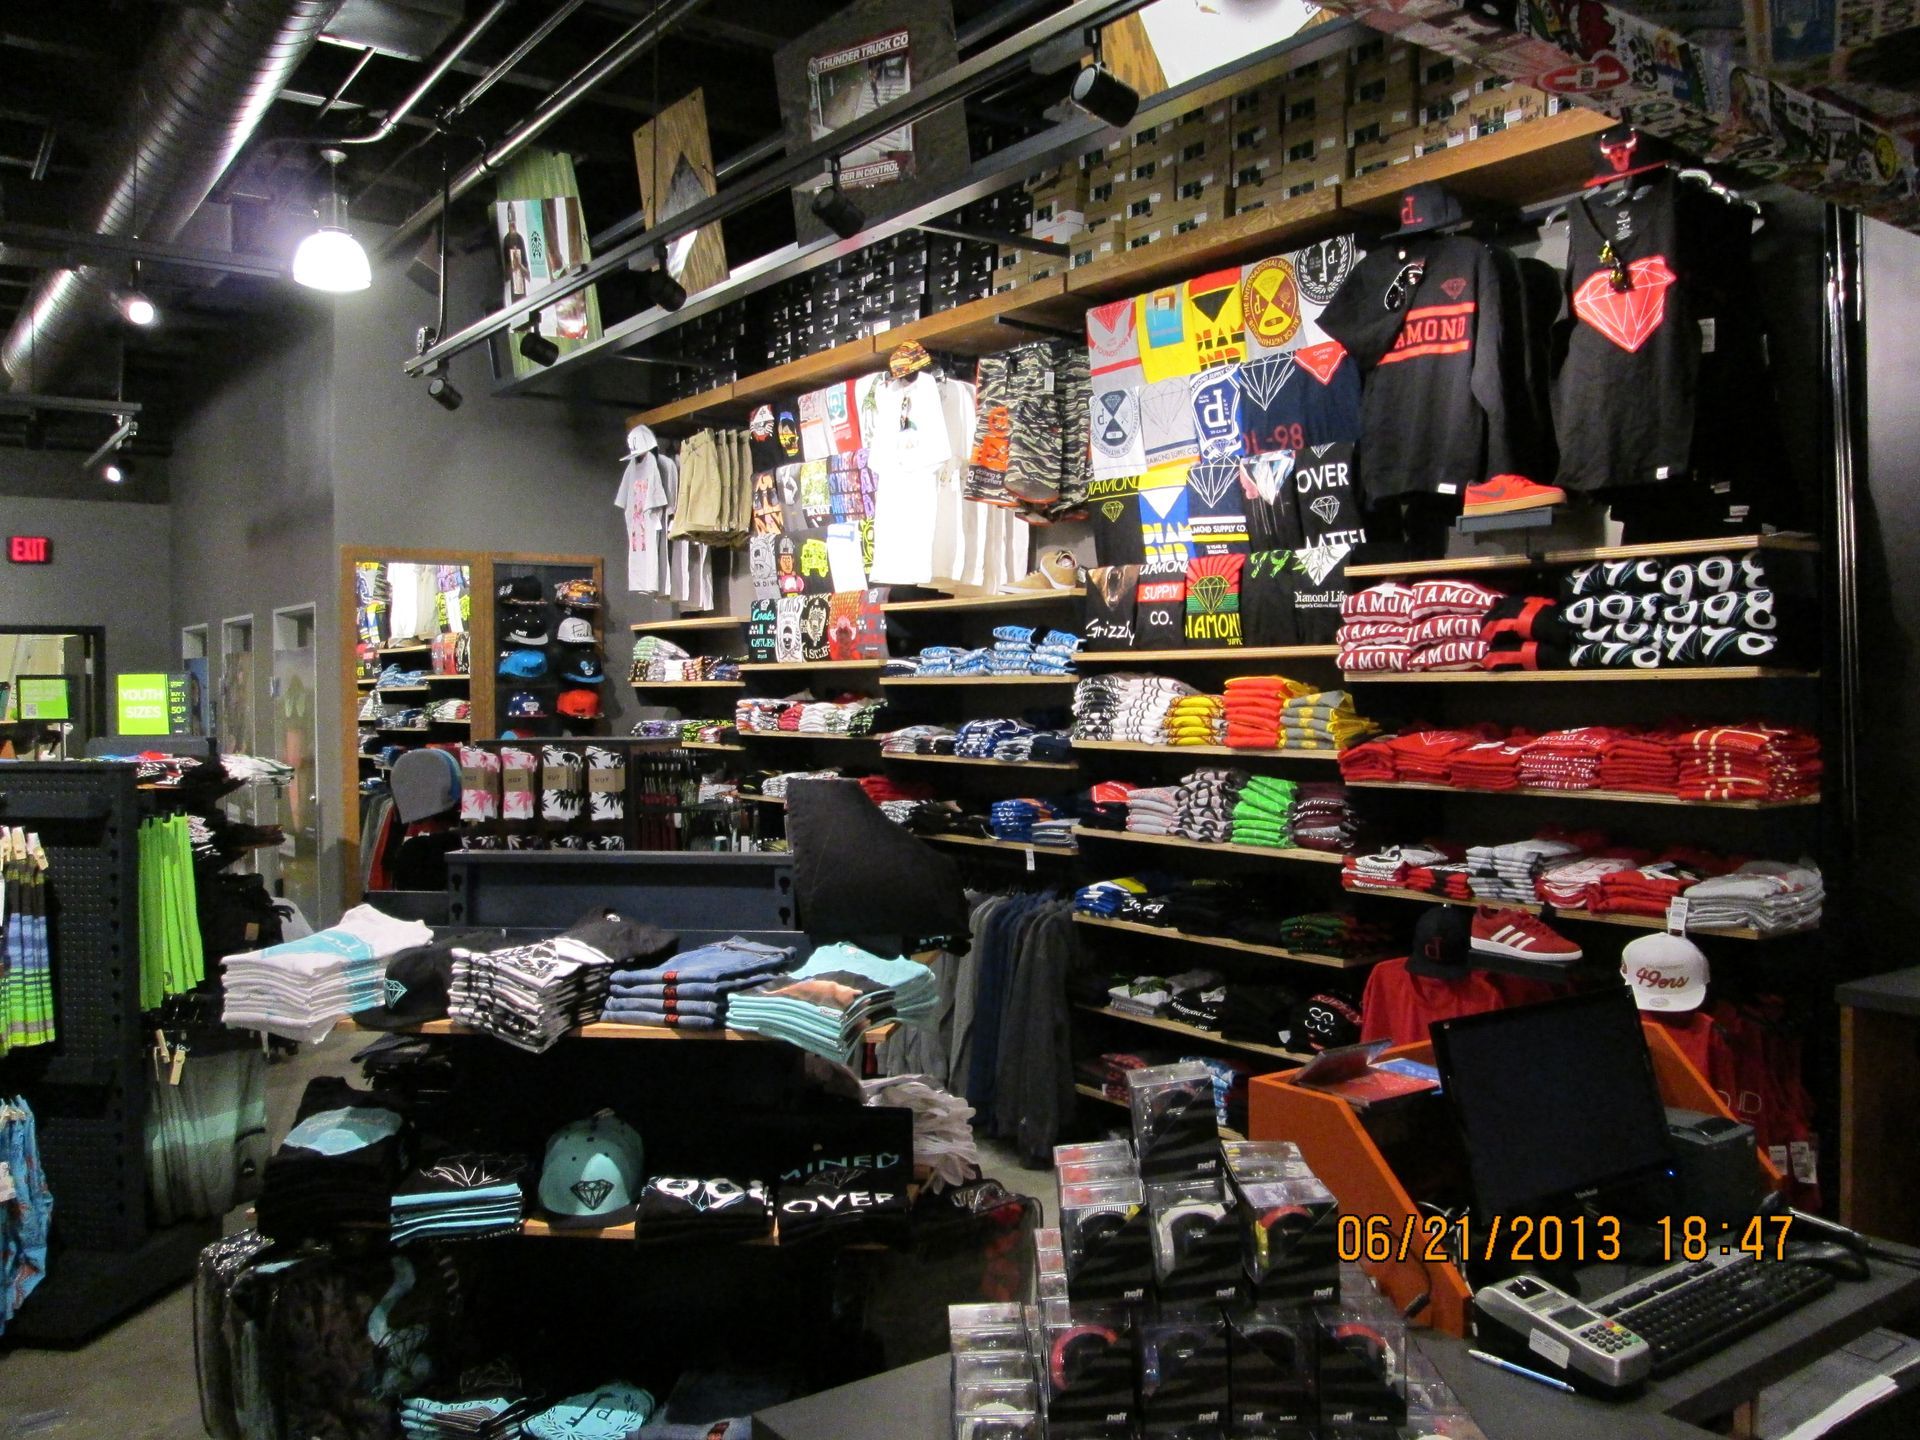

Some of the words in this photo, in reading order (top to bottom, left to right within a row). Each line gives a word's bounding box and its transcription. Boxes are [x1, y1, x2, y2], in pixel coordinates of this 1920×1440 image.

[819, 50, 860, 68] THUNDER
[861, 38, 892, 57] TRUCK
[893, 33, 909, 47] CO
[855, 170, 864, 182] IN
[864, 162, 899, 178] CONTROL
[1295, 462, 1349, 494] OVER
[1213, 525, 1236, 533] SUPPLY
[12, 535, 47, 561] EXIT
[1143, 585, 1179, 600] SUPPLY
[1150, 610, 1173, 626] CO.
[1086, 618, 1135, 646] Grizzly
[121, 689, 164, 702] YOUTH
[125, 705, 162, 719] SIZES
[1636, 966, 1690, 990] 49ers
[1197, 1159, 1217, 1171] neff
[1124, 1288, 1144, 1299] neff
[1216, 1286, 1236, 1298] neff
[1313, 1286, 1334, 1298] neff
[1106, 1411, 1127, 1422] neff
[1198, 1410, 1219, 1421] neff
[1243, 1411, 1264, 1422] neff
[1333, 1411, 1353, 1422] neff
